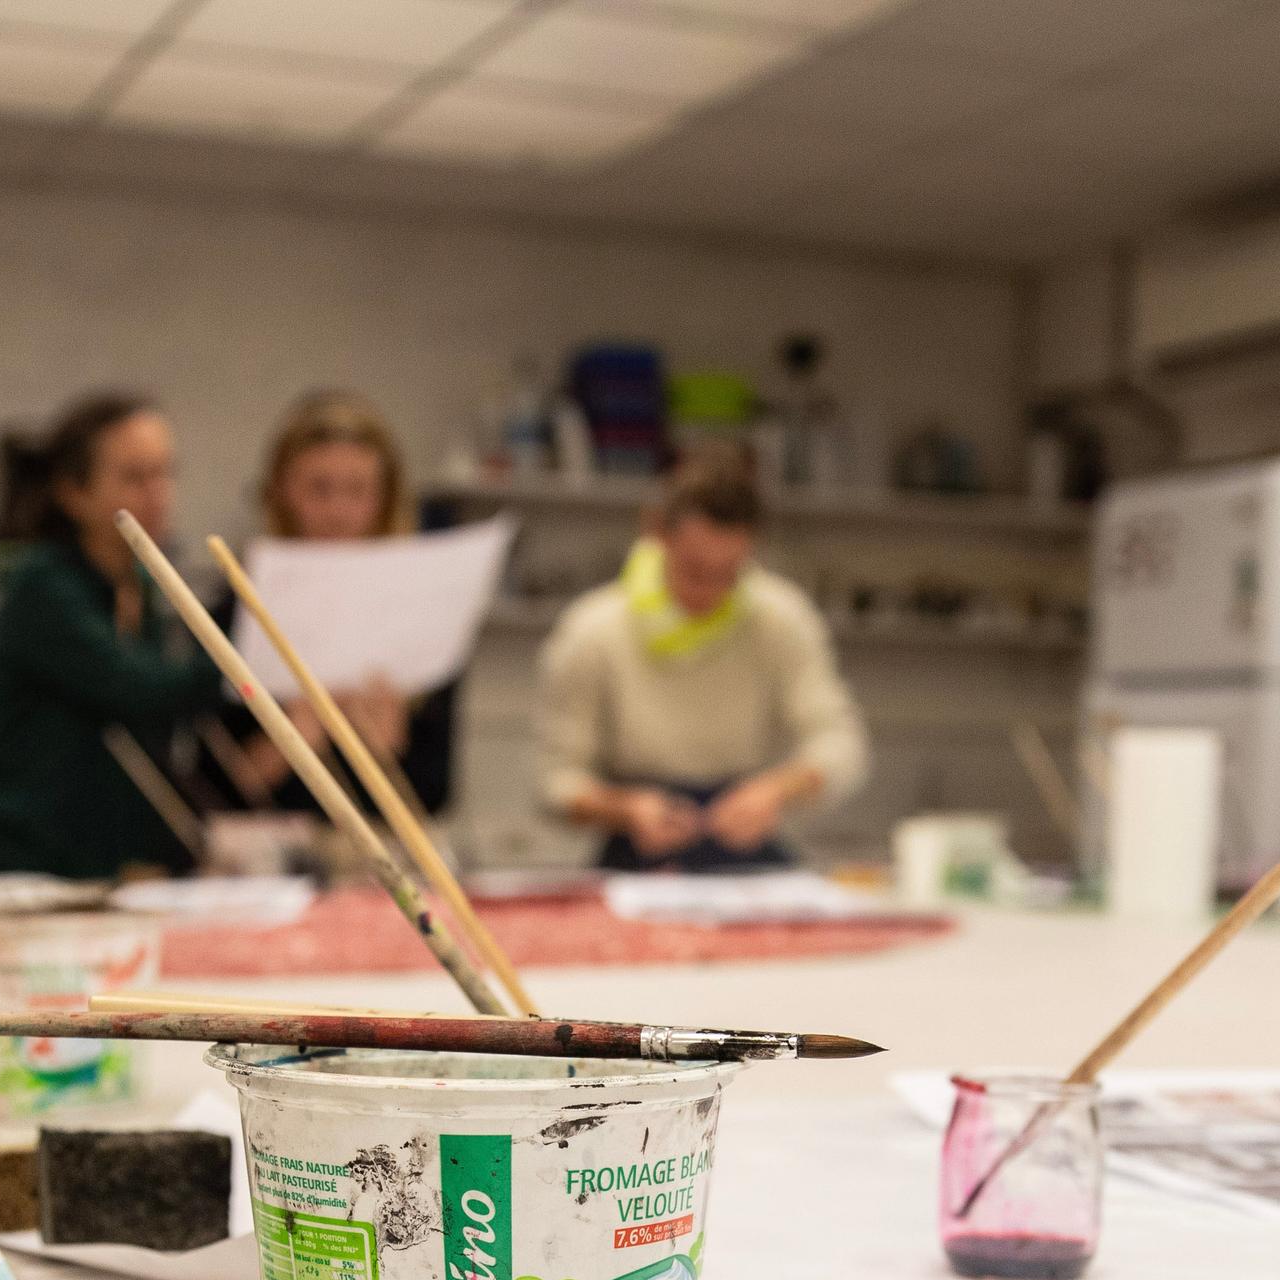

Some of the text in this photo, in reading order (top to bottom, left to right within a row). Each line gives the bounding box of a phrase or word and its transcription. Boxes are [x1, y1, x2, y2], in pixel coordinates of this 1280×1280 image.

[280, 1156, 304, 1172] FRAIS
[565, 1149, 713, 1195] FROMAGE BLAN
[282, 1173, 338, 1193] PASTEURISÉ
[616, 1178, 695, 1223] VELOUTÉ
[617, 1228, 652, 1248] 7,6%
